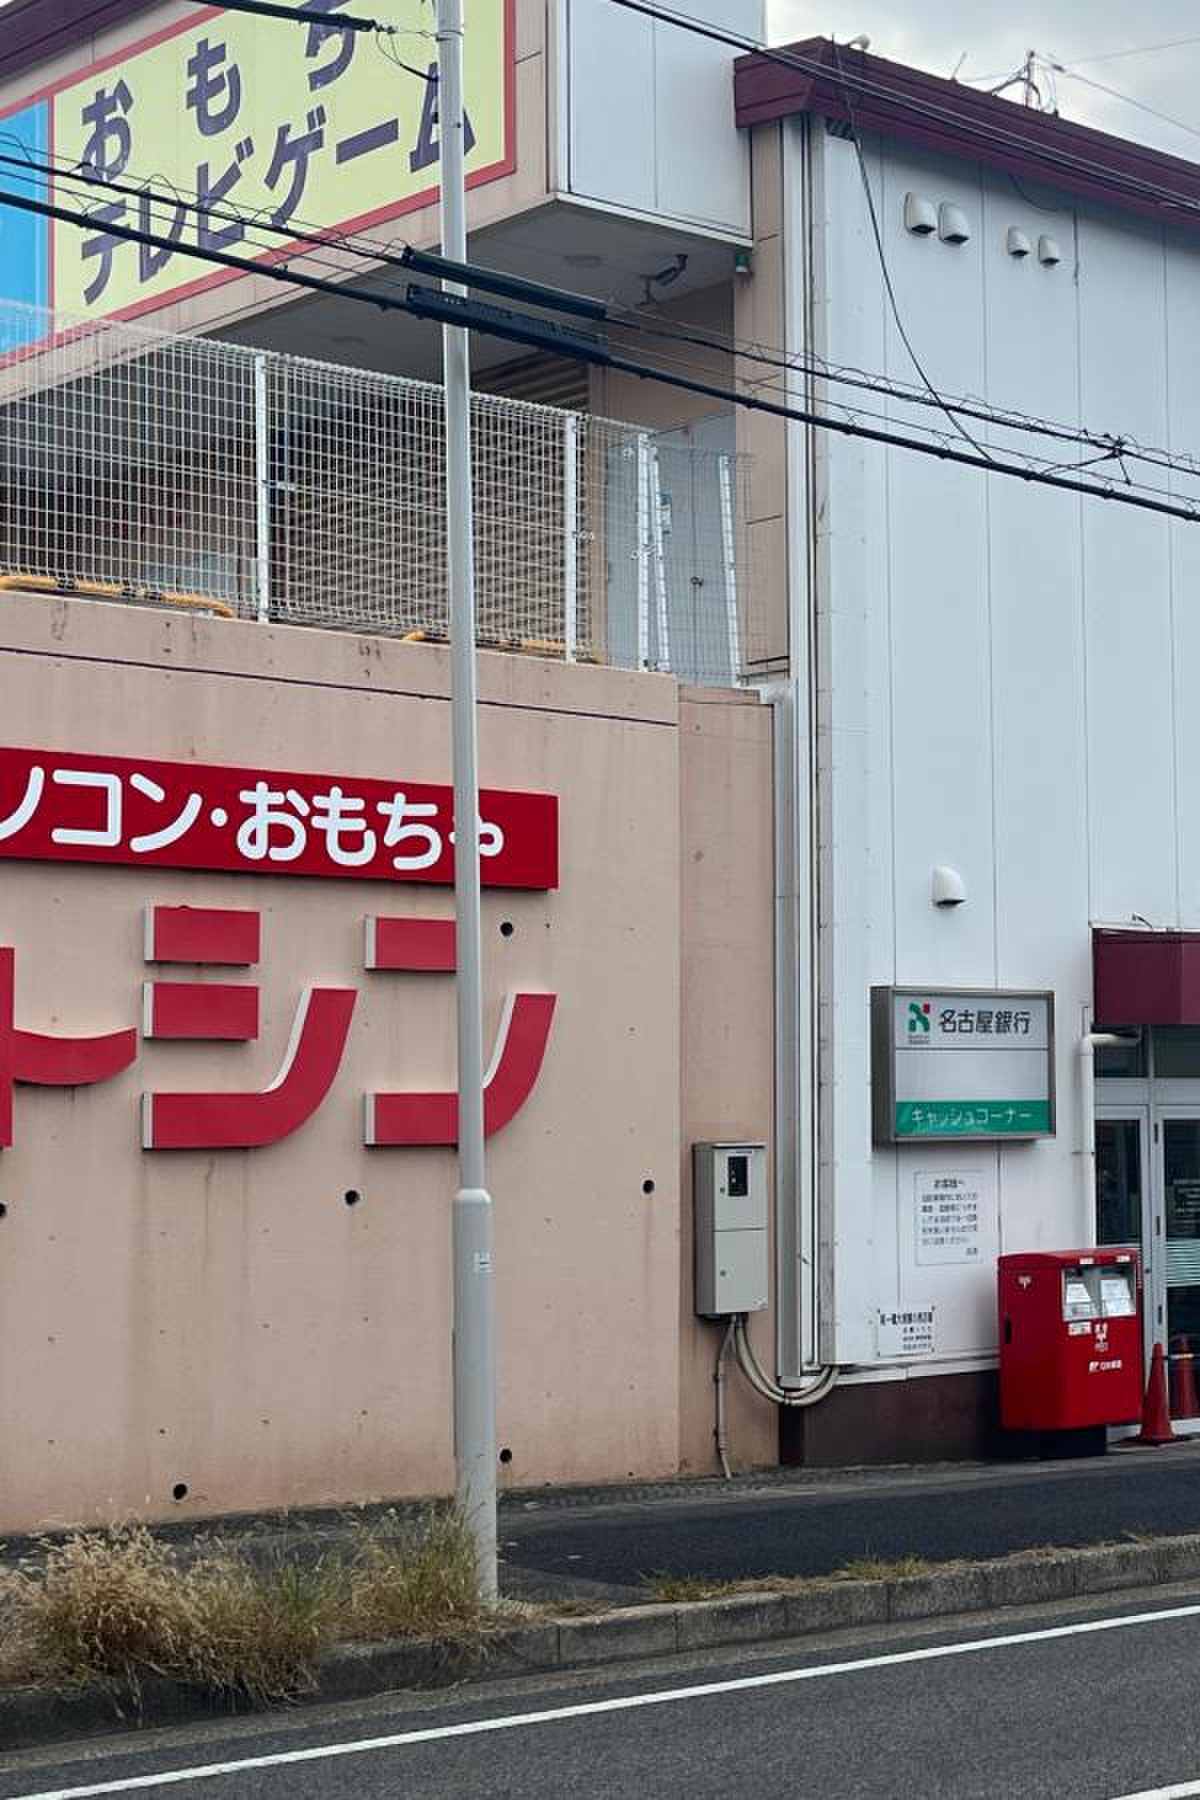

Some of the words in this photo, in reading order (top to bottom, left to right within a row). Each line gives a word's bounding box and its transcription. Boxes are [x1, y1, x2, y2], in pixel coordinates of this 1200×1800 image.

[81, 62, 477, 305] テレビゲーム
[939, 1008, 1031, 1035] 名古屋銀行
[911, 1106, 1033, 1127] キャッシュコーナー
